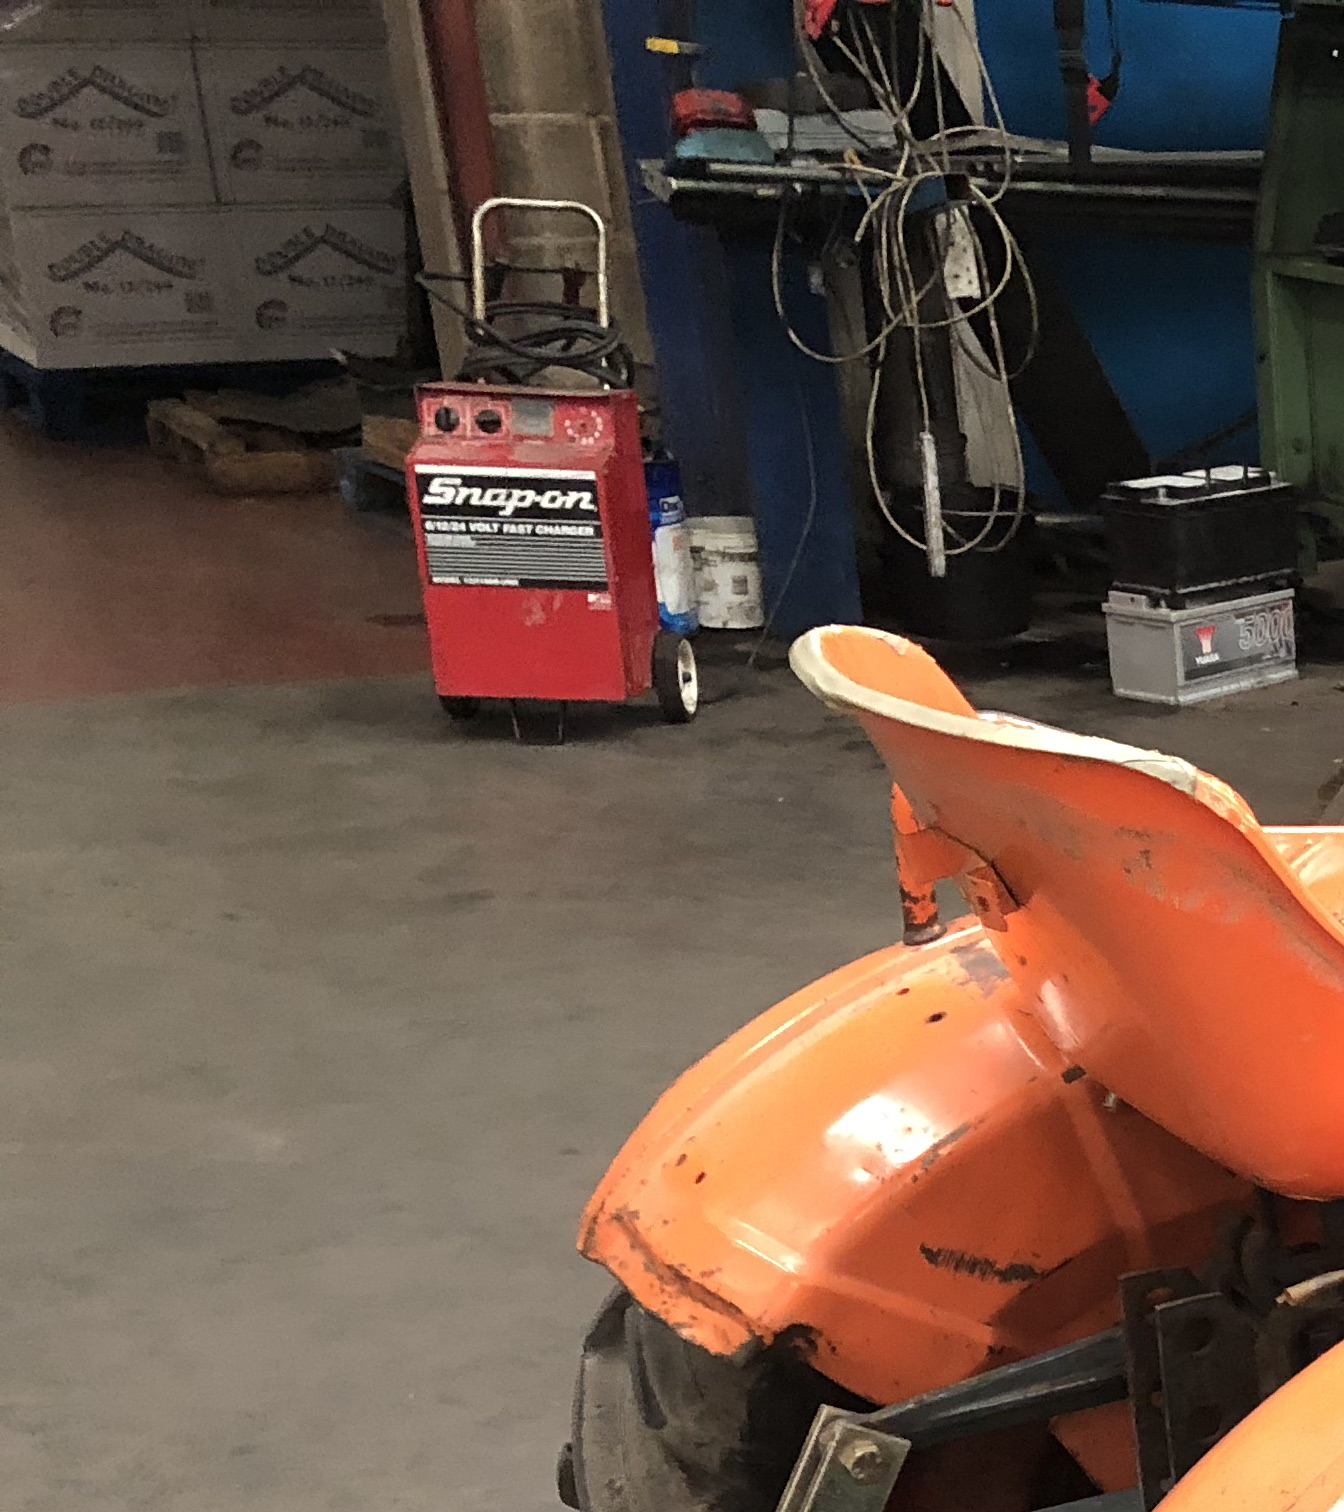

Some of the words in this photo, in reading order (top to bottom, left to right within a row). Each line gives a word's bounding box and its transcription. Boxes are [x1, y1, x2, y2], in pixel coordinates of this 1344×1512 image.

[422, 477, 596, 516] Snap-on
[469, 521, 500, 533] VOLT
[502, 522, 534, 535] FAST
[534, 523, 595, 537] CHARGER
